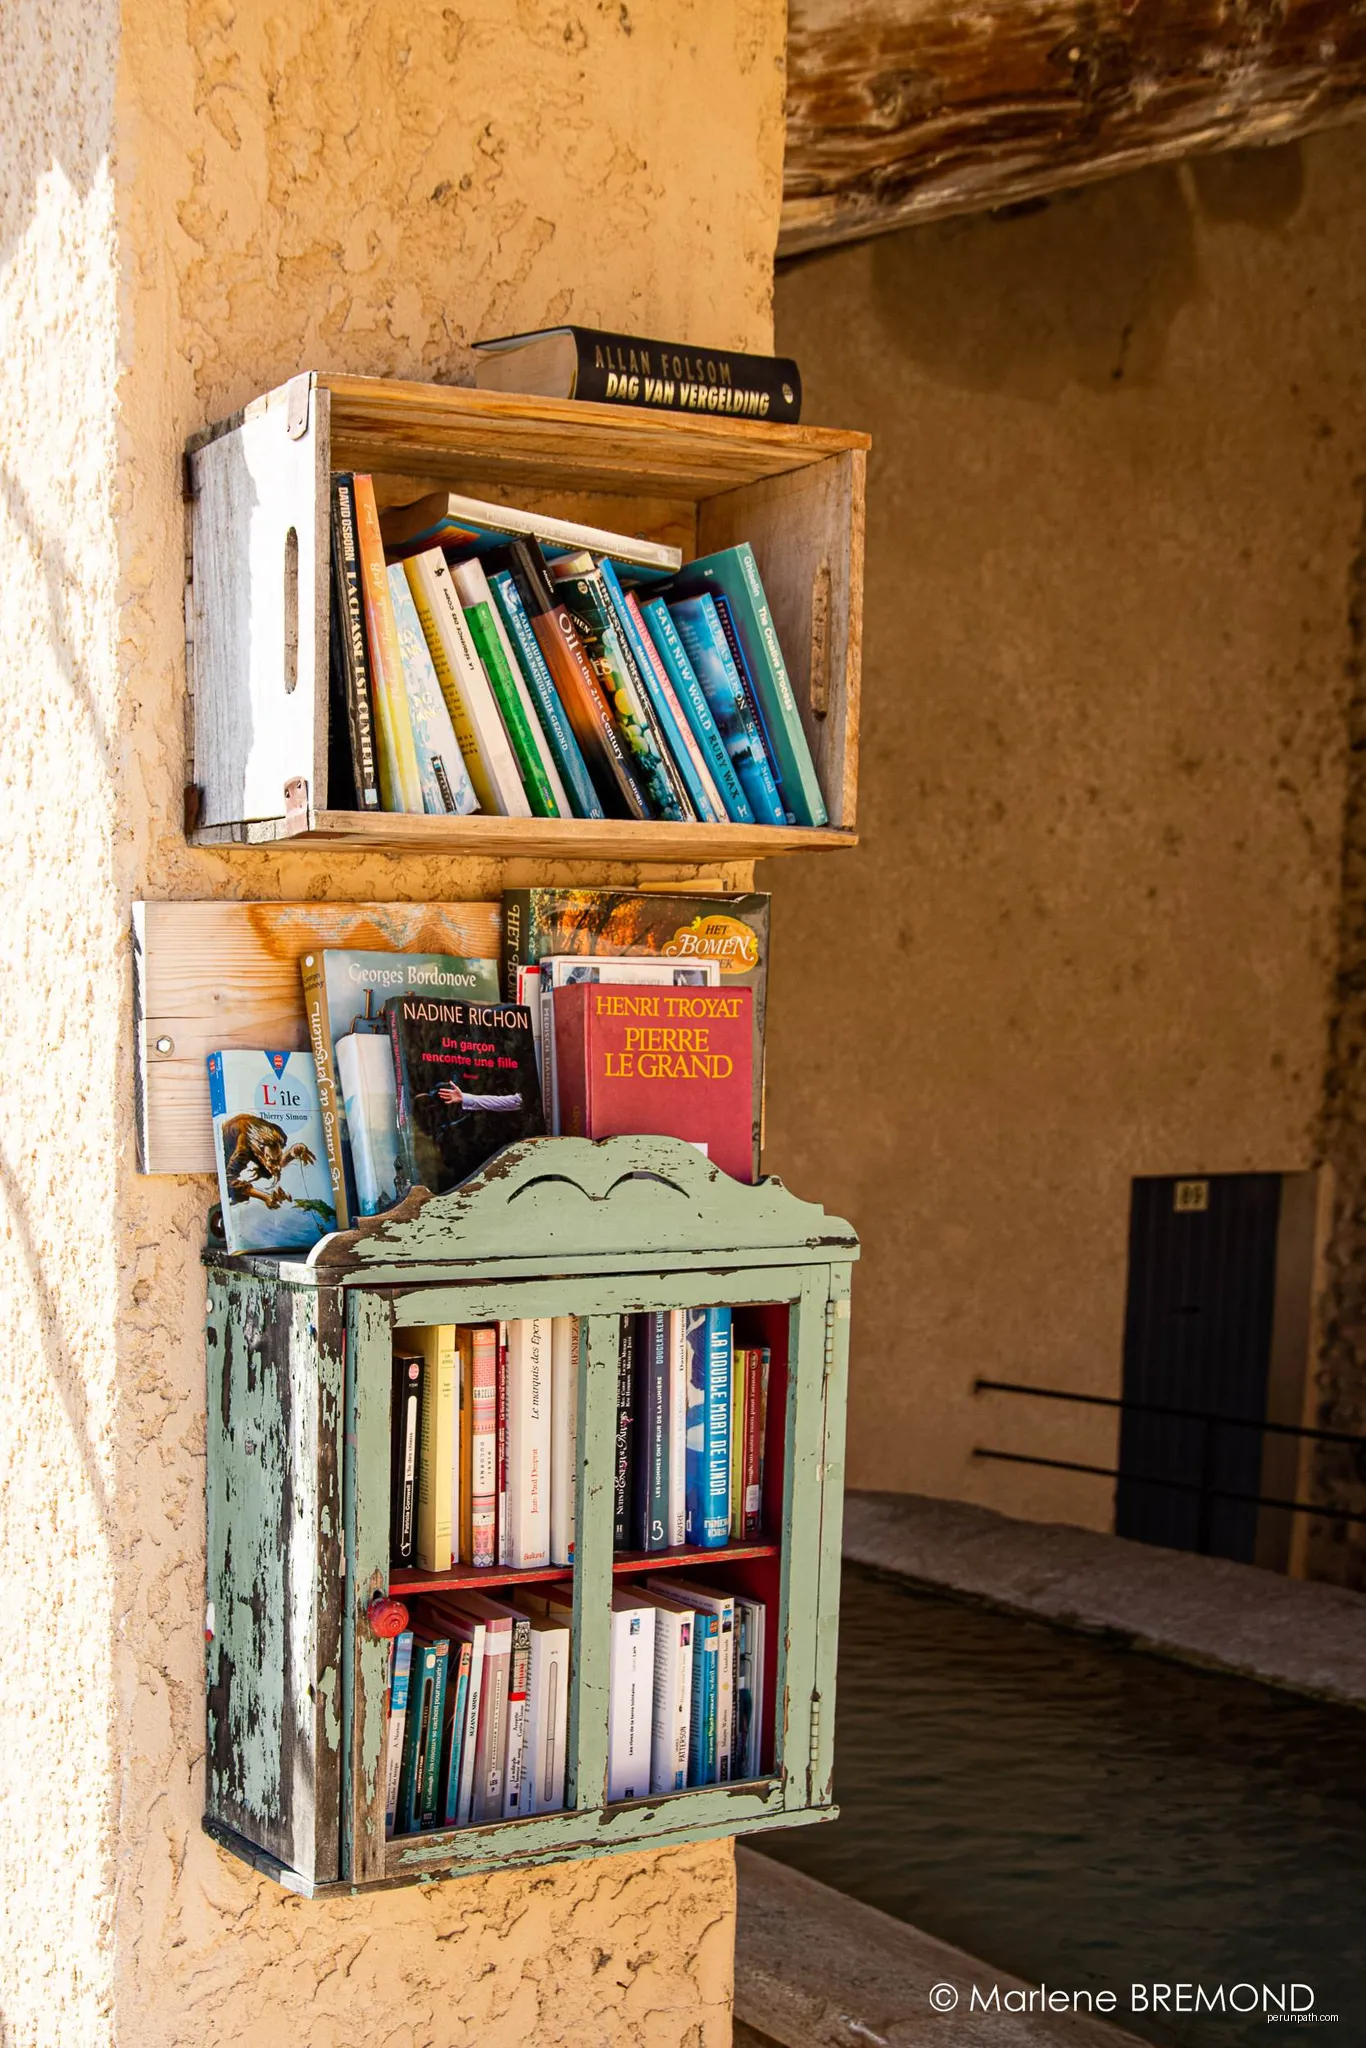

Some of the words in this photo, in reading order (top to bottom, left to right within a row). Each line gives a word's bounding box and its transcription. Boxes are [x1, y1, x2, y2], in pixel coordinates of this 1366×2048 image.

[595, 345, 650, 374] ALLAN
[661, 353, 732, 385] FOLSOM
[605, 372, 639, 400] DAG
[644, 377, 675, 405] VAN
[680, 382, 770, 417] VERGELDING
[338, 487, 350, 517] DAVID
[341, 518, 354, 561] OSBORN
[346, 572, 358, 596] LA
[744, 555, 760, 597] Ghiselin
[348, 598, 363, 660] CHASSE
[706, 605, 730, 660] THOMAS
[519, 612, 533, 642] KARIN
[530, 642, 554, 693] HUBBELING
[758, 605, 768, 627] The
[764, 627, 780, 668] Creative
[775, 670, 793, 712] Process
[355, 667, 367, 695] EST
[512, 616, 521, 628] UW
[518, 629, 533, 659] PAARD
[530, 659, 554, 716] NATUURLIJK
[550, 715, 568, 750] GEZOND
[656, 607, 677, 645] SANE
[673, 647, 692, 681] NEW
[688, 683, 712, 731] WORLD
[559, 613, 579, 651] Oil
[576, 652, 585, 665] in
[581, 667, 593, 686] the
[591, 688, 604, 710] 21st
[601, 712, 624, 760] Century
[709, 734, 727, 768] RUBY
[724, 771, 741, 799] WAX
[761, 766, 774, 793] Stand
[629, 778, 643, 806] OXFORD
[507, 904, 520, 954] HET
[705, 925, 729, 936] HET
[666, 934, 754, 961] BOMEN
[348, 963, 404, 987] Georges
[407, 966, 477, 988] Bordonove
[403, 1003, 464, 1024] NADINE
[469, 1005, 528, 1029] RICHON
[596, 996, 660, 1017] HENRI
[664, 997, 743, 1018] TROYAT
[442, 1038, 457, 1048] Un
[460, 1040, 495, 1054] garçon
[624, 1028, 710, 1052] PIERRE
[422, 1052, 471, 1067] rencontre
[474, 1057, 494, 1067] une
[498, 1056, 518, 1069] fille
[604, 1053, 634, 1077] LE
[637, 1054, 734, 1078] GRAND
[319, 1089, 329, 1107] de
[259, 1112, 284, 1122] Thierry
[286, 1113, 308, 1122] Simon
[656, 1333, 664, 1364] DOUGLAS
[711, 1331, 727, 1347] LA
[531, 1347, 540, 1363] des
[531, 1366, 542, 1406] marquis
[710, 1351, 727, 1400] DOUBLE
[531, 1407, 540, 1420] Le
[657, 1405, 662, 1414] LA
[657, 1415, 662, 1424] DE
[710, 1403, 727, 1435] MORT
[710, 1440, 727, 1456] DE
[710, 1460, 727, 1496] LINDA
[531, 1478, 540, 1514] Jean-Paul
[678, 1725, 687, 1762] PATTERSON
